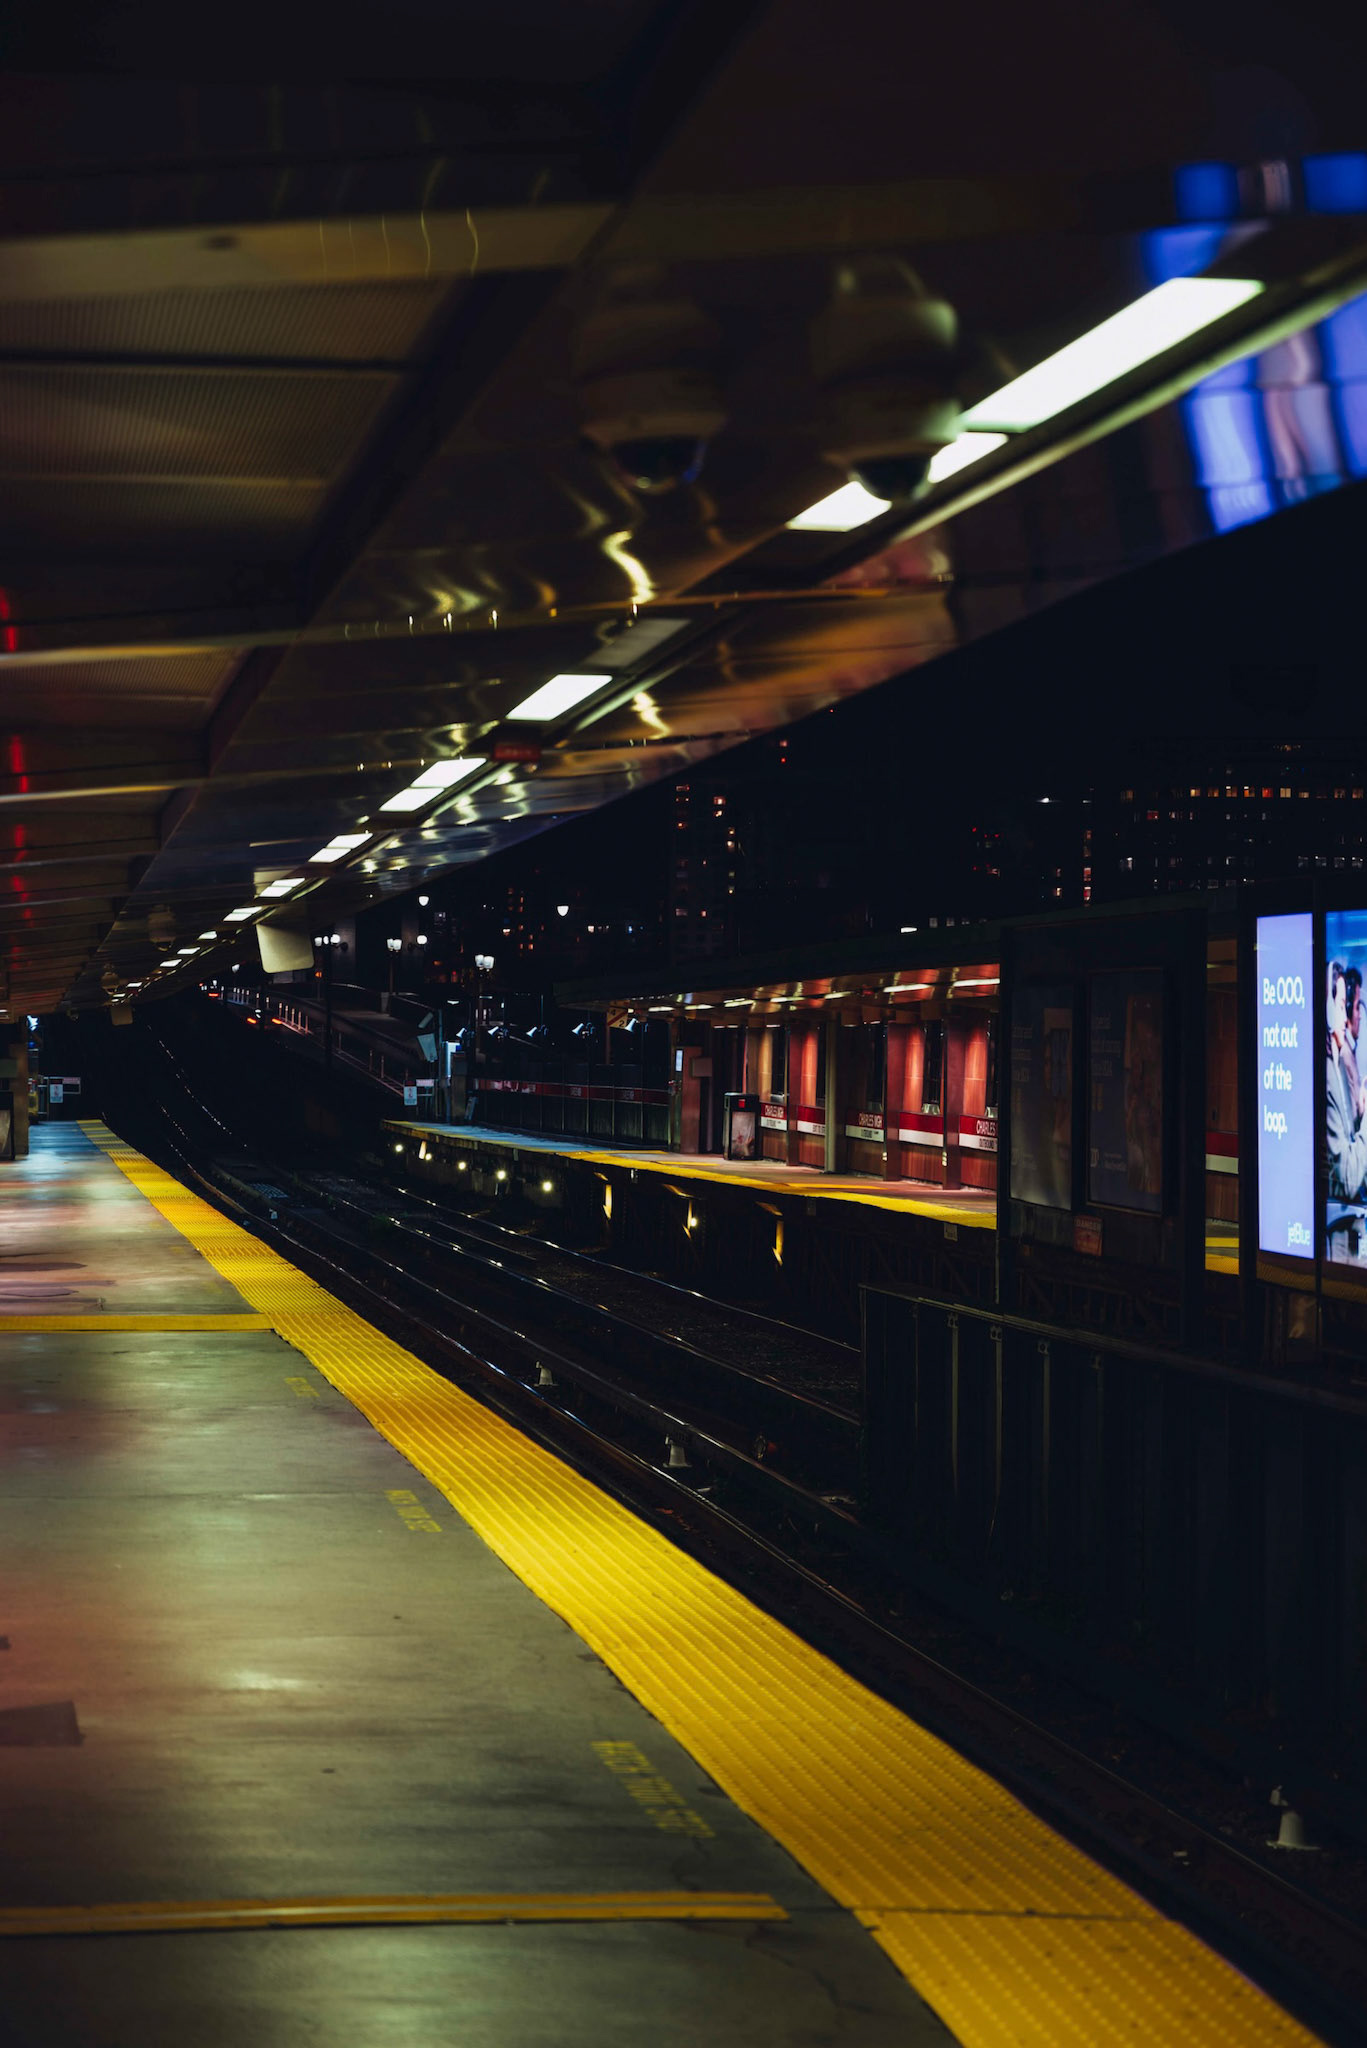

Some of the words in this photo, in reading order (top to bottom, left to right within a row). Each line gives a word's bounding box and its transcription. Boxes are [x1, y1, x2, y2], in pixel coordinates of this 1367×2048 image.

[1263, 977, 1276, 1005] Be
[1277, 976, 1305, 1009] OOO,
[1263, 1022, 1279, 1048] not
[1281, 1022, 1298, 1048] out
[1263, 1062, 1275, 1090] of
[1275, 1063, 1292, 1091] the
[1263, 1105, 1287, 1139] loop.
